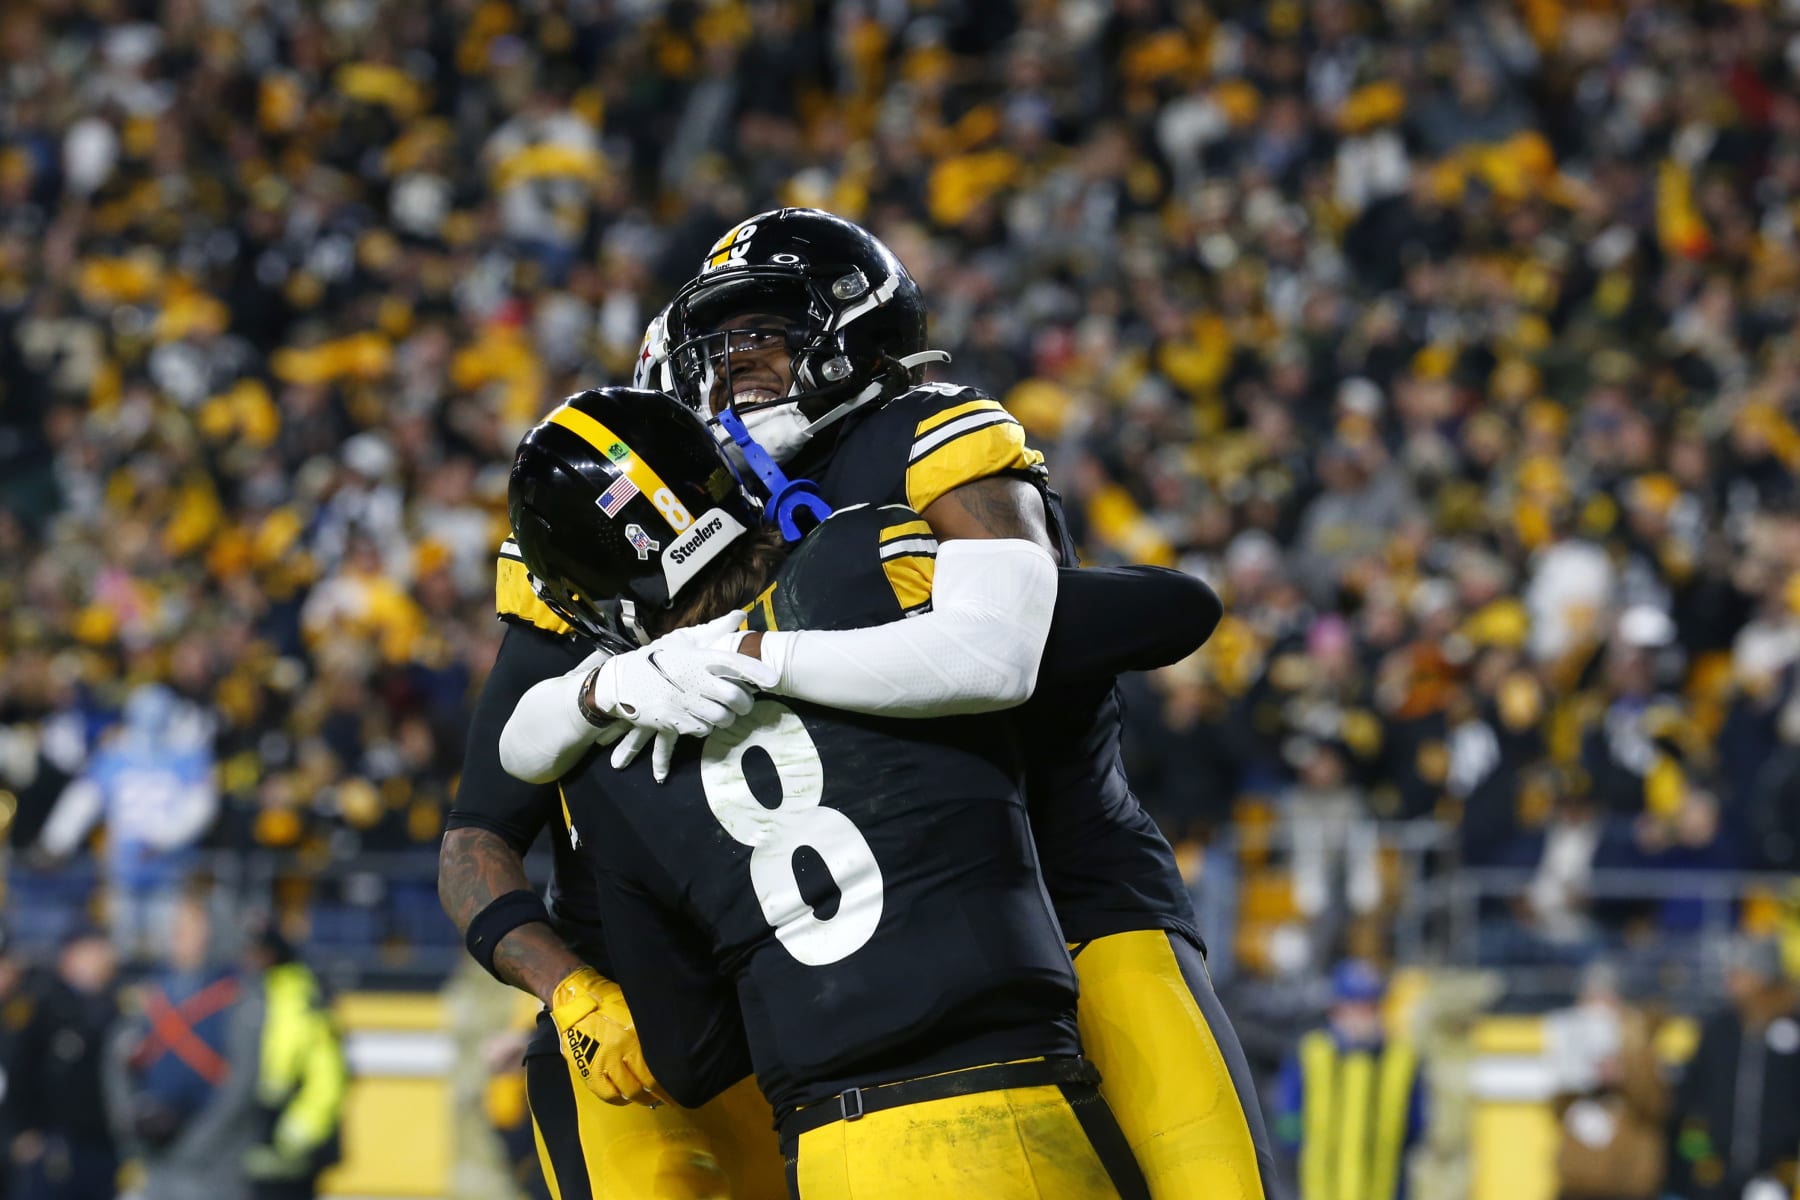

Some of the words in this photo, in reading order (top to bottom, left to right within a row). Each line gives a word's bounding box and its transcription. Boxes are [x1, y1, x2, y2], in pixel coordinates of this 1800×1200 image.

[653, 487, 691, 531] 8
[670, 517, 723, 564] Steelers
[701, 698, 884, 966] 8
[567, 1028, 590, 1078] adidas
